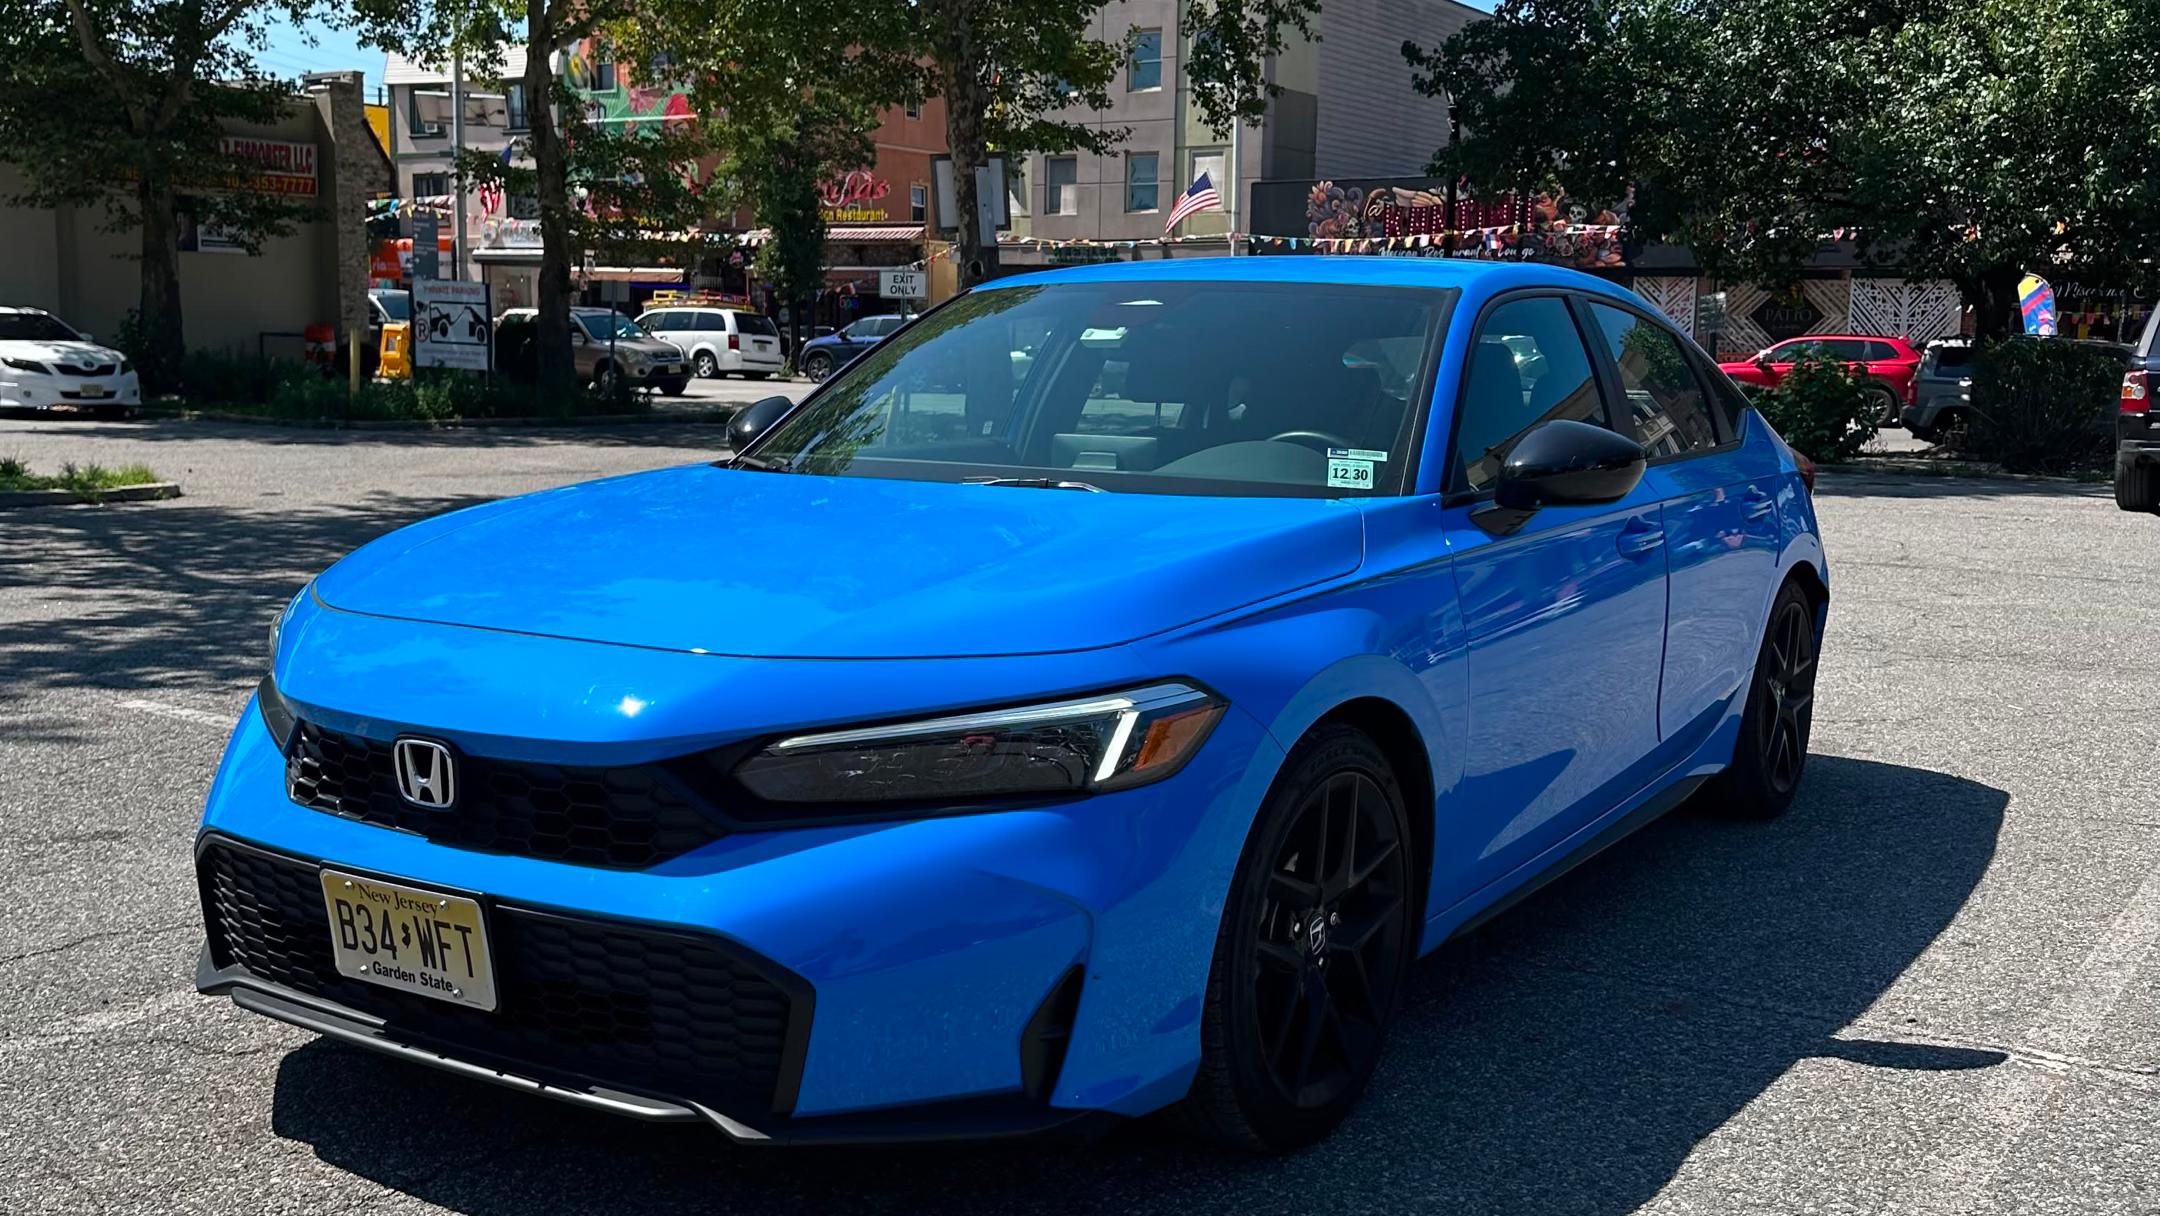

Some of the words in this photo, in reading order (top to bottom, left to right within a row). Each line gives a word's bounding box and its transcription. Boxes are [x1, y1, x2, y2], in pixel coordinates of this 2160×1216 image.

[293, 145, 313, 174] LLC
[836, 208, 886, 223] Restaurant
[1496, 245, 1536, 260] Louge
[893, 274, 914, 284] EXIT
[890, 285, 917, 295] ONLY
[1332, 467, 1350, 480] 12
[1352, 468, 1368, 481] 30
[357, 883, 391, 905] New
[394, 891, 438, 918] Jersey
[335, 898, 398, 960] B34
[412, 915, 474, 978] WFT
[372, 961, 416, 984] Garden
[420, 972, 453, 993] State
